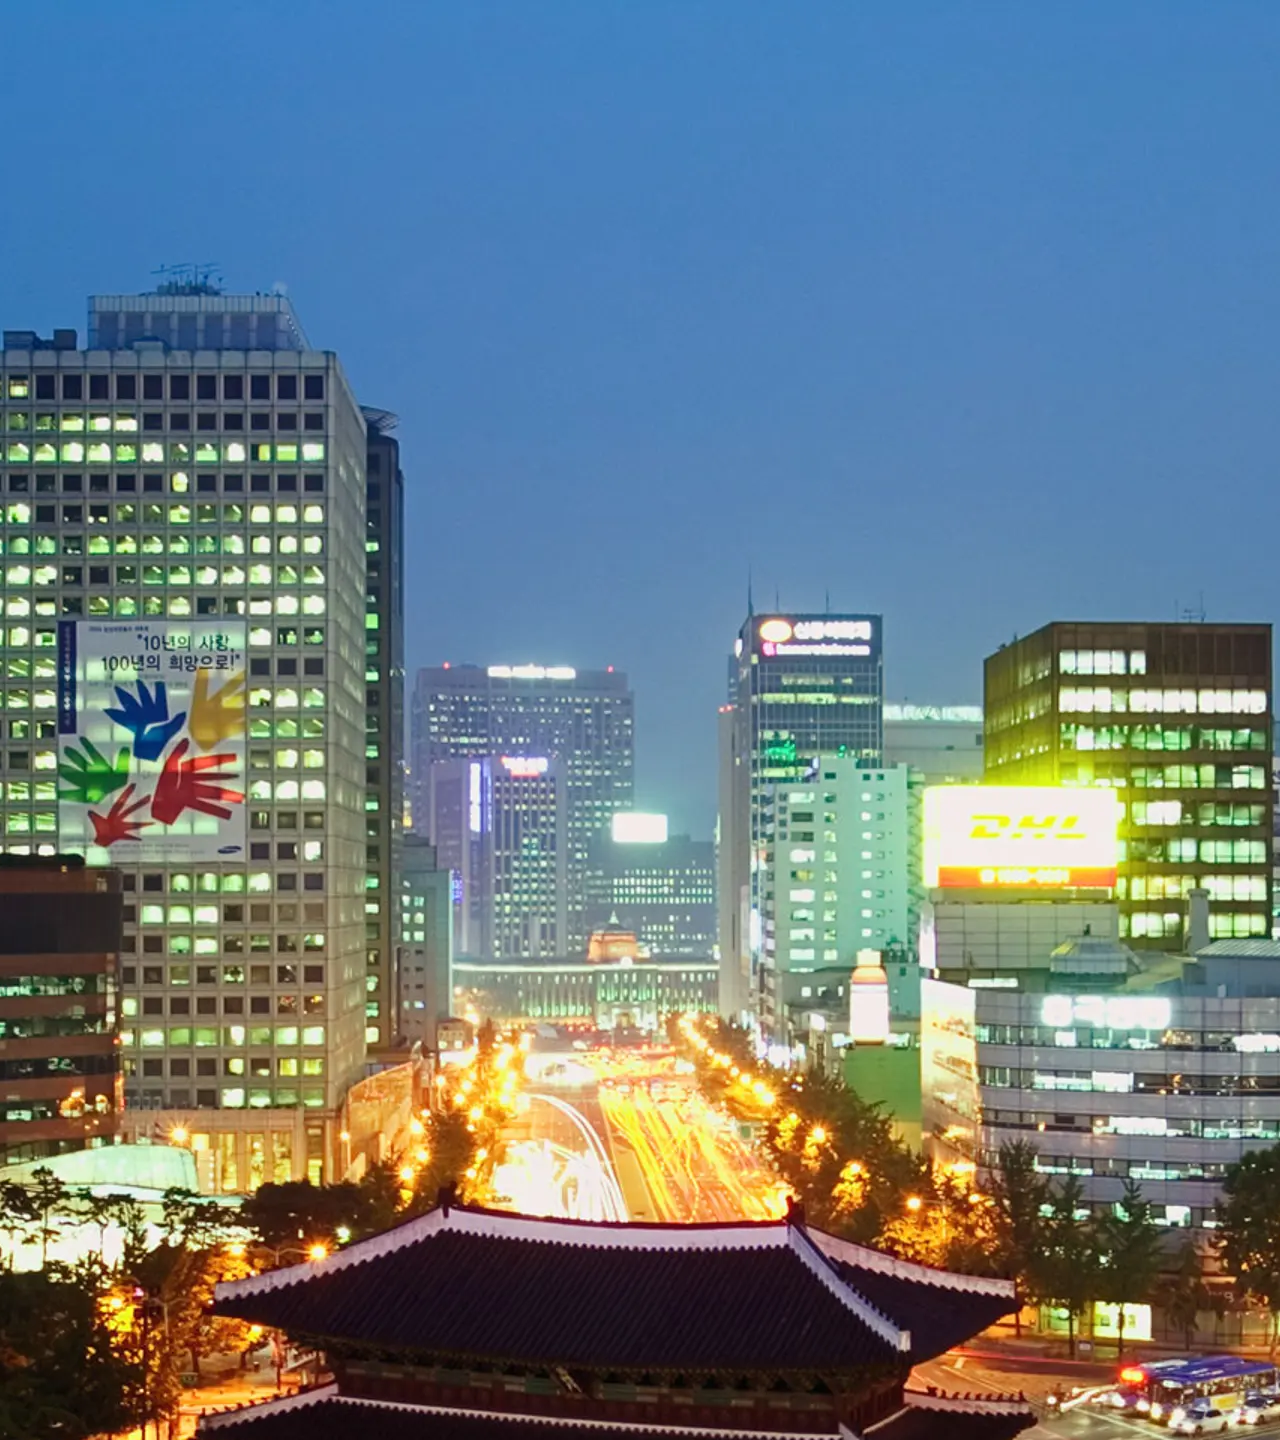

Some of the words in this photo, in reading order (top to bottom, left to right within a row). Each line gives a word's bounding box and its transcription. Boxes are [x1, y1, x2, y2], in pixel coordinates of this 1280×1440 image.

[198, 633, 236, 652] 사랑,
[101, 653, 161, 672] 100년의
[969, 814, 1087, 839] DHL
